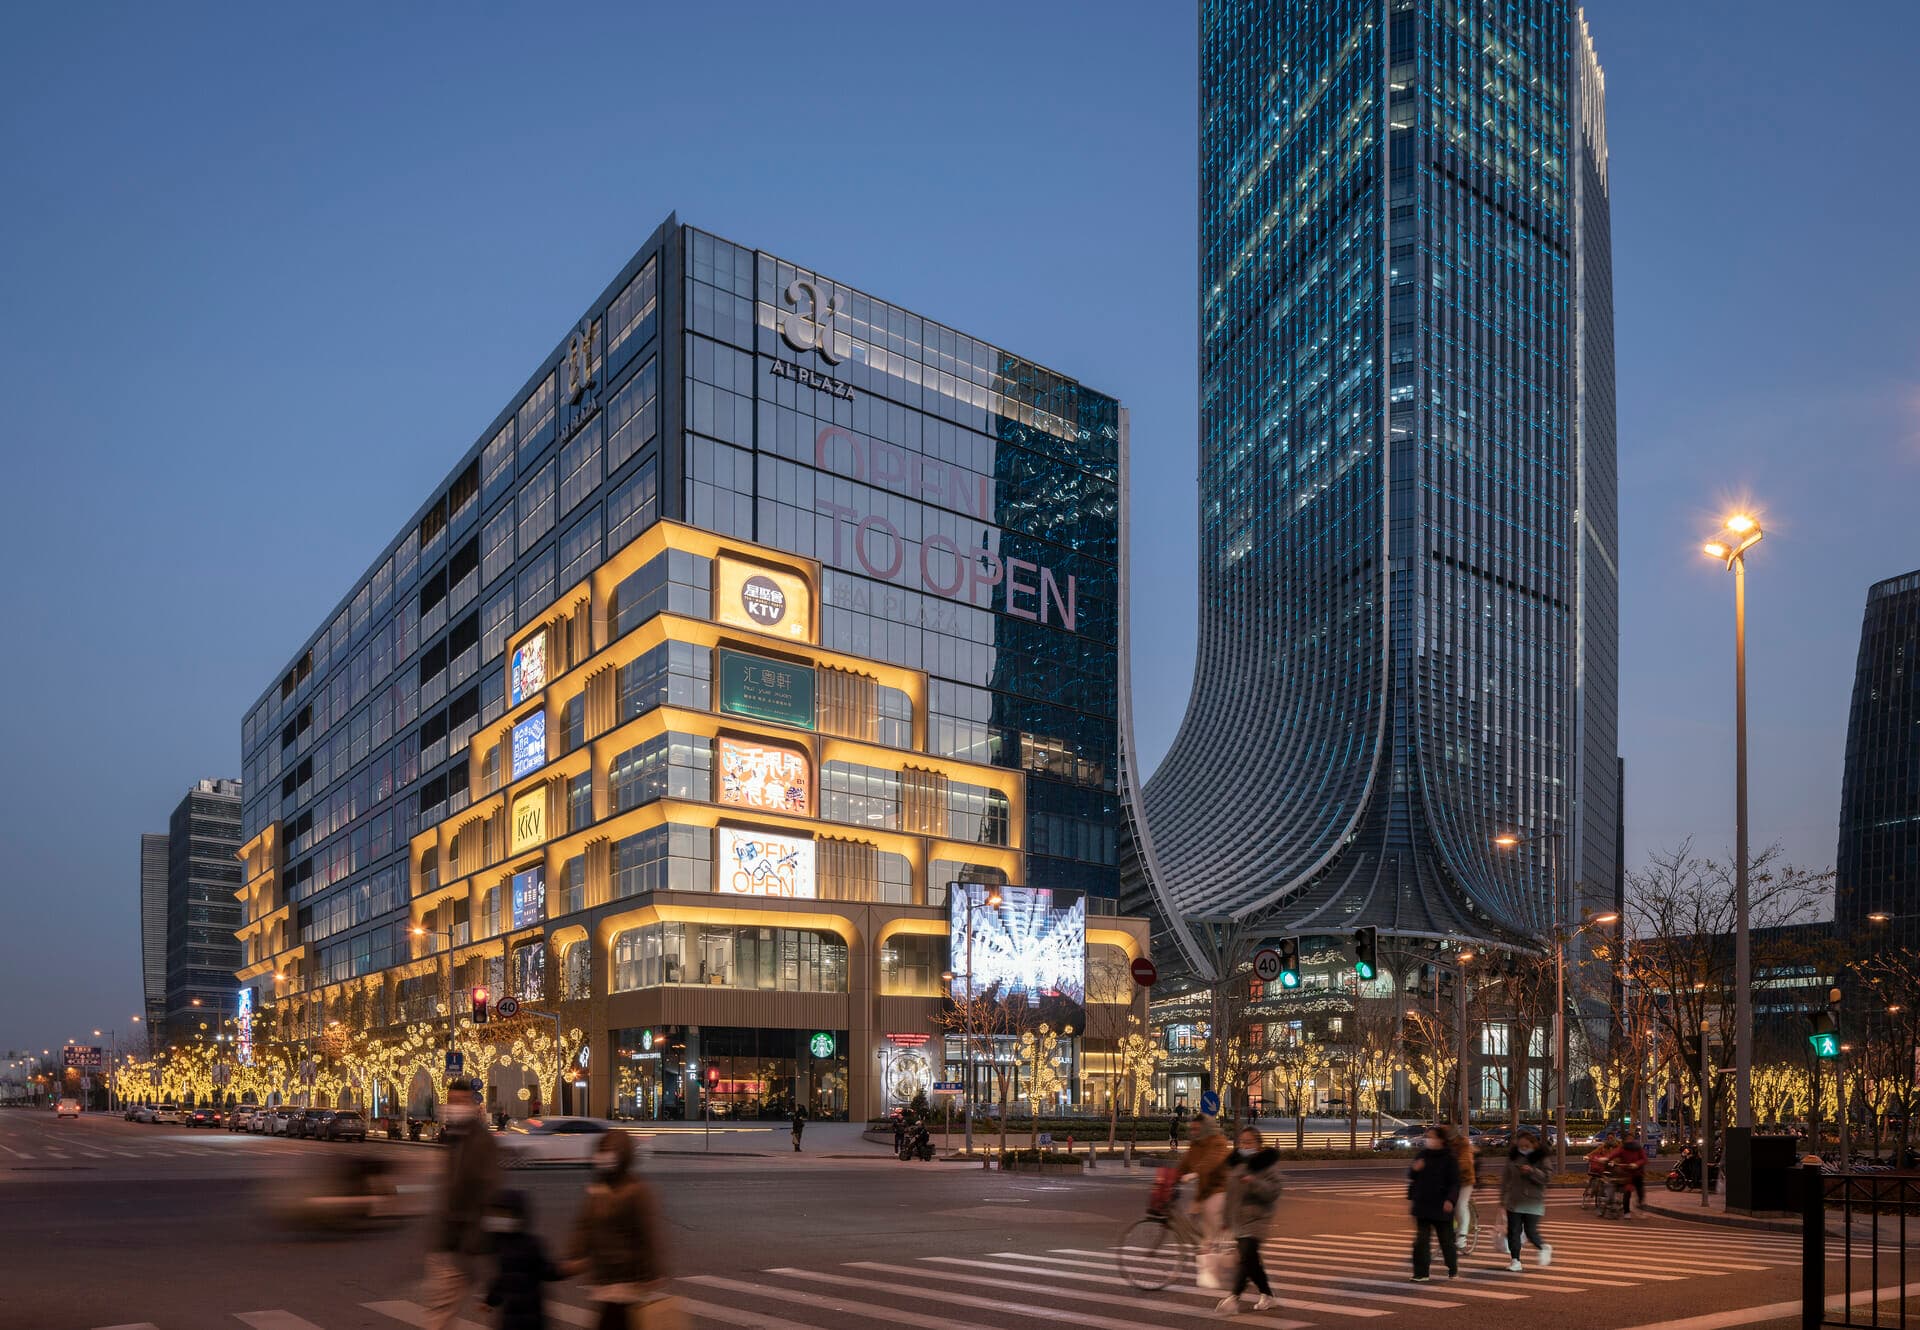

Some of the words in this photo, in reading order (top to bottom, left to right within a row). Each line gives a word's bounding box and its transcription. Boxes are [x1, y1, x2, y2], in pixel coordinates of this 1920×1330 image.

[798, 368, 856, 401] PLAZA
[816, 426, 988, 521] OPEN
[816, 498, 903, 579] TO
[920, 534, 1076, 632] OPEN
[748, 601, 780, 619] KTV
[732, 871, 795, 897] OPEN
[1259, 958, 1277, 973] 40
[500, 1002, 515, 1012] 40
